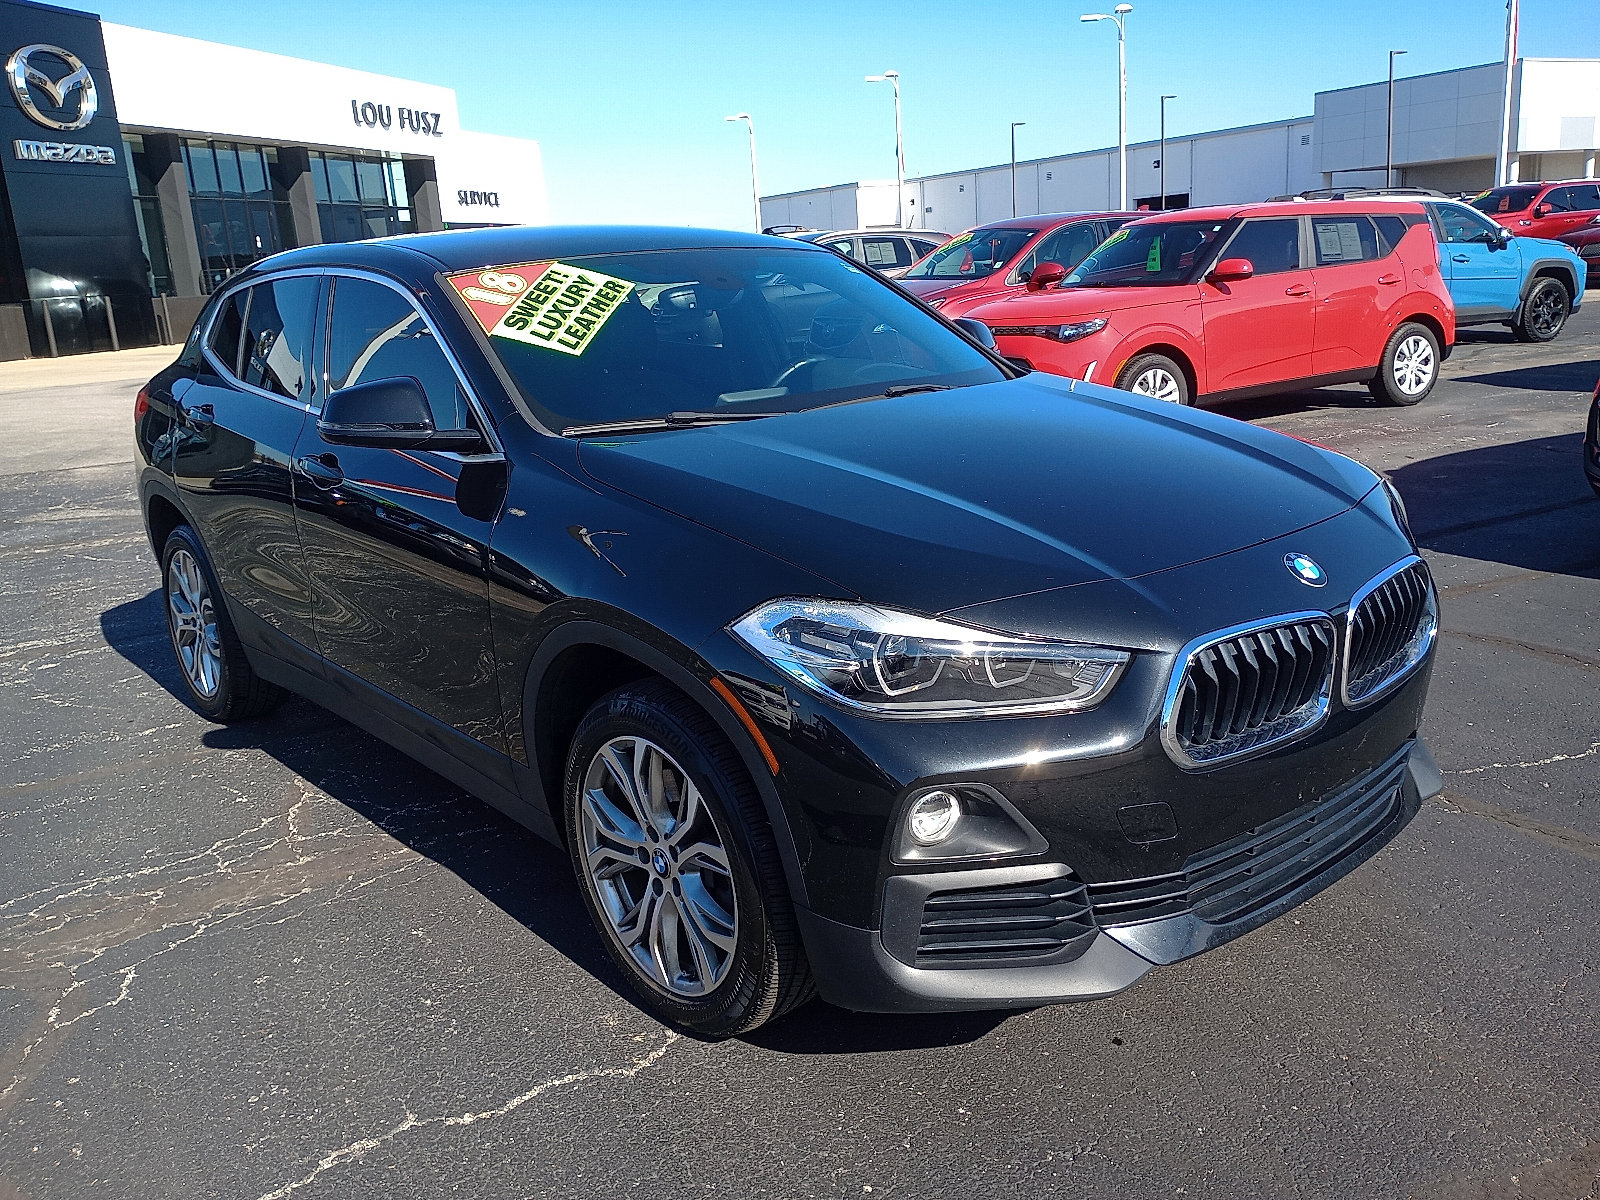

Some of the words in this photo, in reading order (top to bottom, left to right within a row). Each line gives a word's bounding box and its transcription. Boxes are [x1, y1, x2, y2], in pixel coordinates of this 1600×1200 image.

[351, 100, 392, 131] LOU
[398, 107, 443, 137] FUSZ
[457, 189, 501, 207] SERVICE
[461, 271, 528, 306] 18
[503, 269, 570, 331] SWEET!
[530, 273, 597, 341] LUXURY
[557, 280, 628, 350] LEATHER
